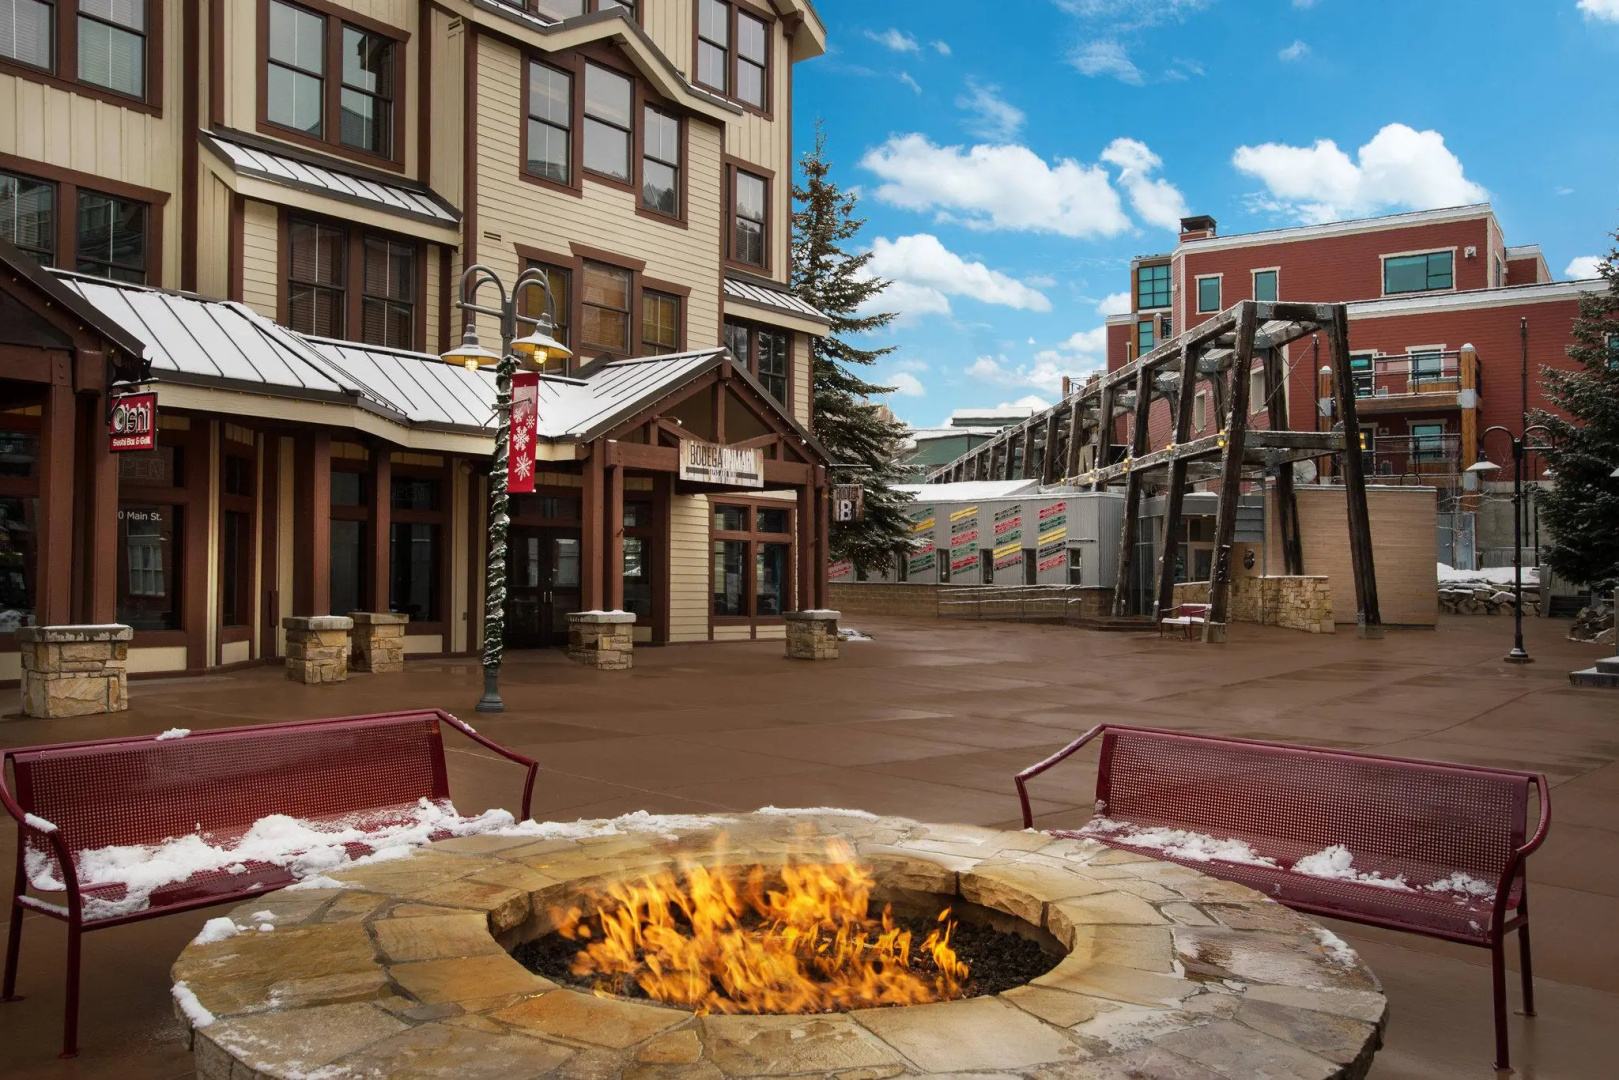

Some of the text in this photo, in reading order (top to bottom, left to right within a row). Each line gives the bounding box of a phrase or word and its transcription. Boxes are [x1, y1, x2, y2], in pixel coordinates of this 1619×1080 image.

[113, 402, 150, 433] Oishi
[113, 438, 126, 447] Sushi
[127, 437, 135, 446] Bar
[140, 436, 151, 445] Grill
[122, 460, 162, 478] PEN
[127, 511, 148, 521] Main
[150, 512, 163, 521] St.
